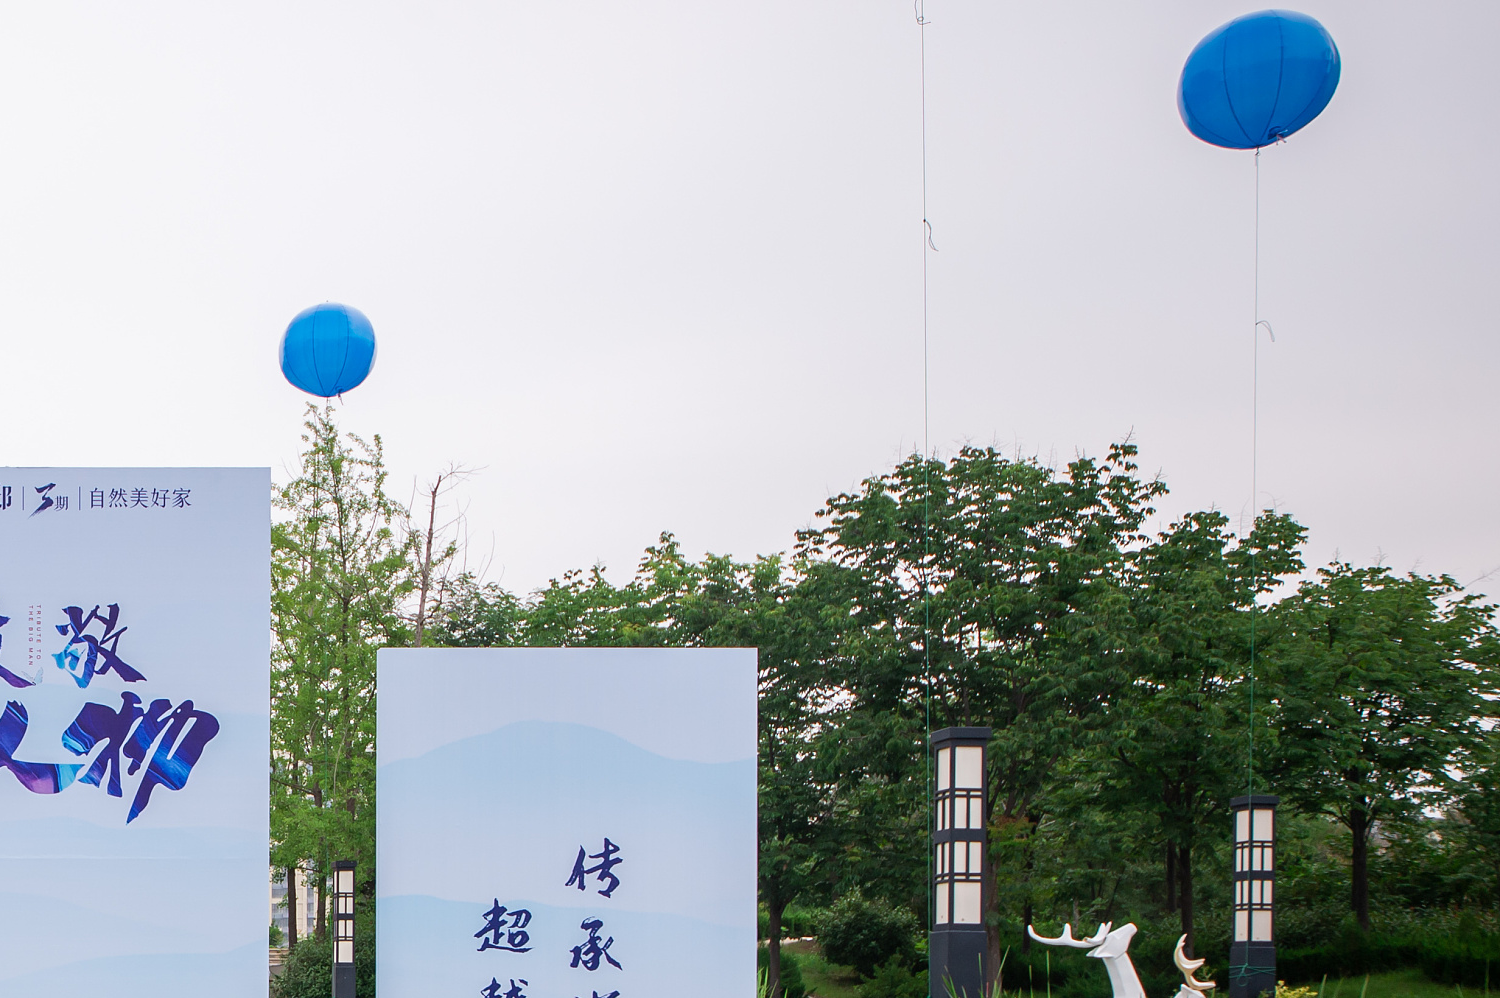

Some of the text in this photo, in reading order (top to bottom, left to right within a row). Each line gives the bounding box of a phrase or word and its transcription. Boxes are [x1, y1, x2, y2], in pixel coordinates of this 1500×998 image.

[89, 487, 192, 509] 自然美好家
[36, 649, 42, 660] TO
